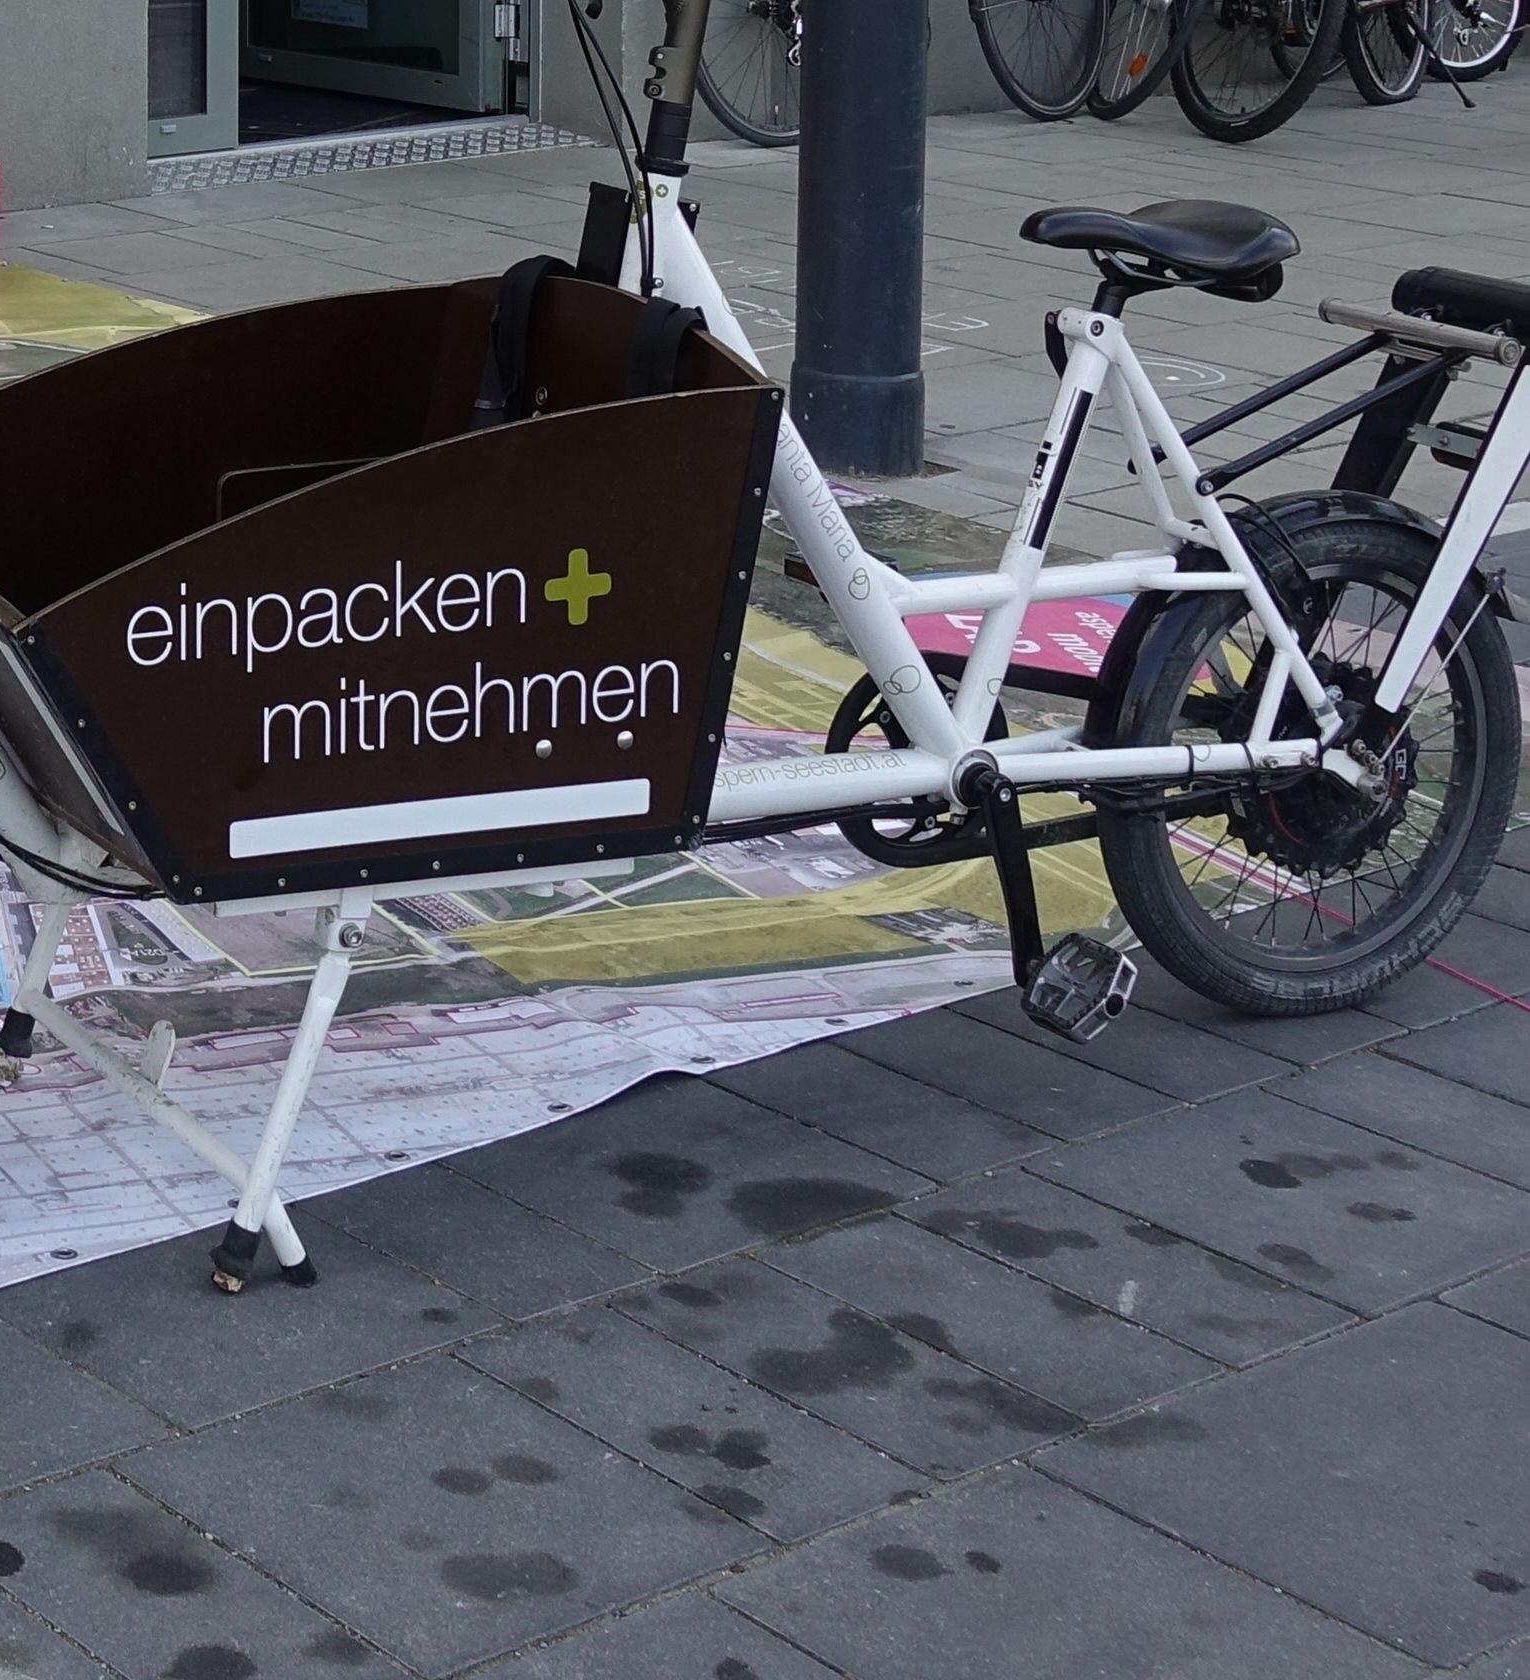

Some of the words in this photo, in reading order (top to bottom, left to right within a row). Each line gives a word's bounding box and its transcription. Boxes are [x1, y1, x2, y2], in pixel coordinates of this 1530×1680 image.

[778, 423, 812, 485] anta
[808, 478, 854, 561] Maria
[127, 560, 527, 672] einpacken
[263, 658, 679, 764] mitnehmen
[714, 752, 906, 791] spern-seestadt.at
